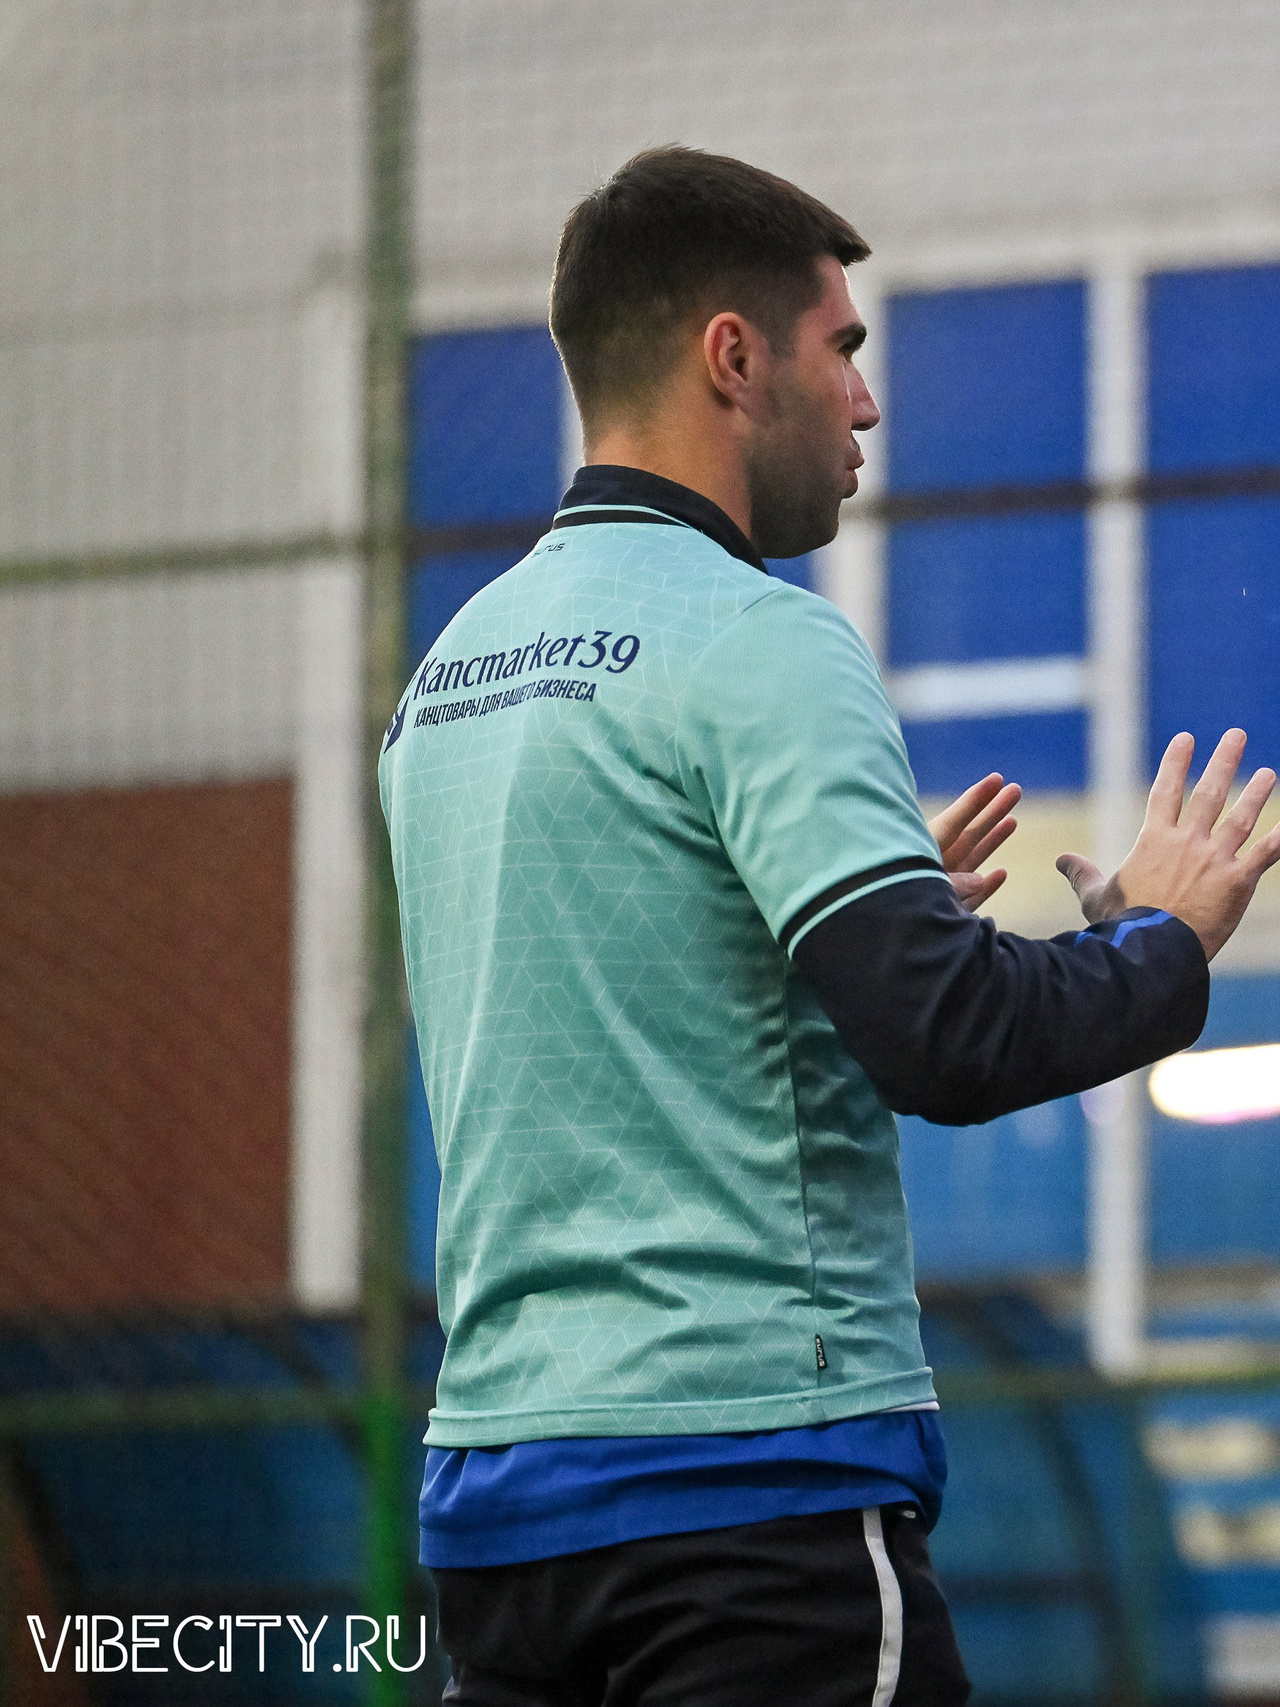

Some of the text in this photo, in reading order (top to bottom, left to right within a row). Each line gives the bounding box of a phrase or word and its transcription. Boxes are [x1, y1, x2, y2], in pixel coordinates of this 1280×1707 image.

[413, 630, 641, 700] Kancmarket39
[413, 678, 598, 729] КАНЦТОВАРЫ ДЛЯ ВАШЕГО БИЗНЕСА
